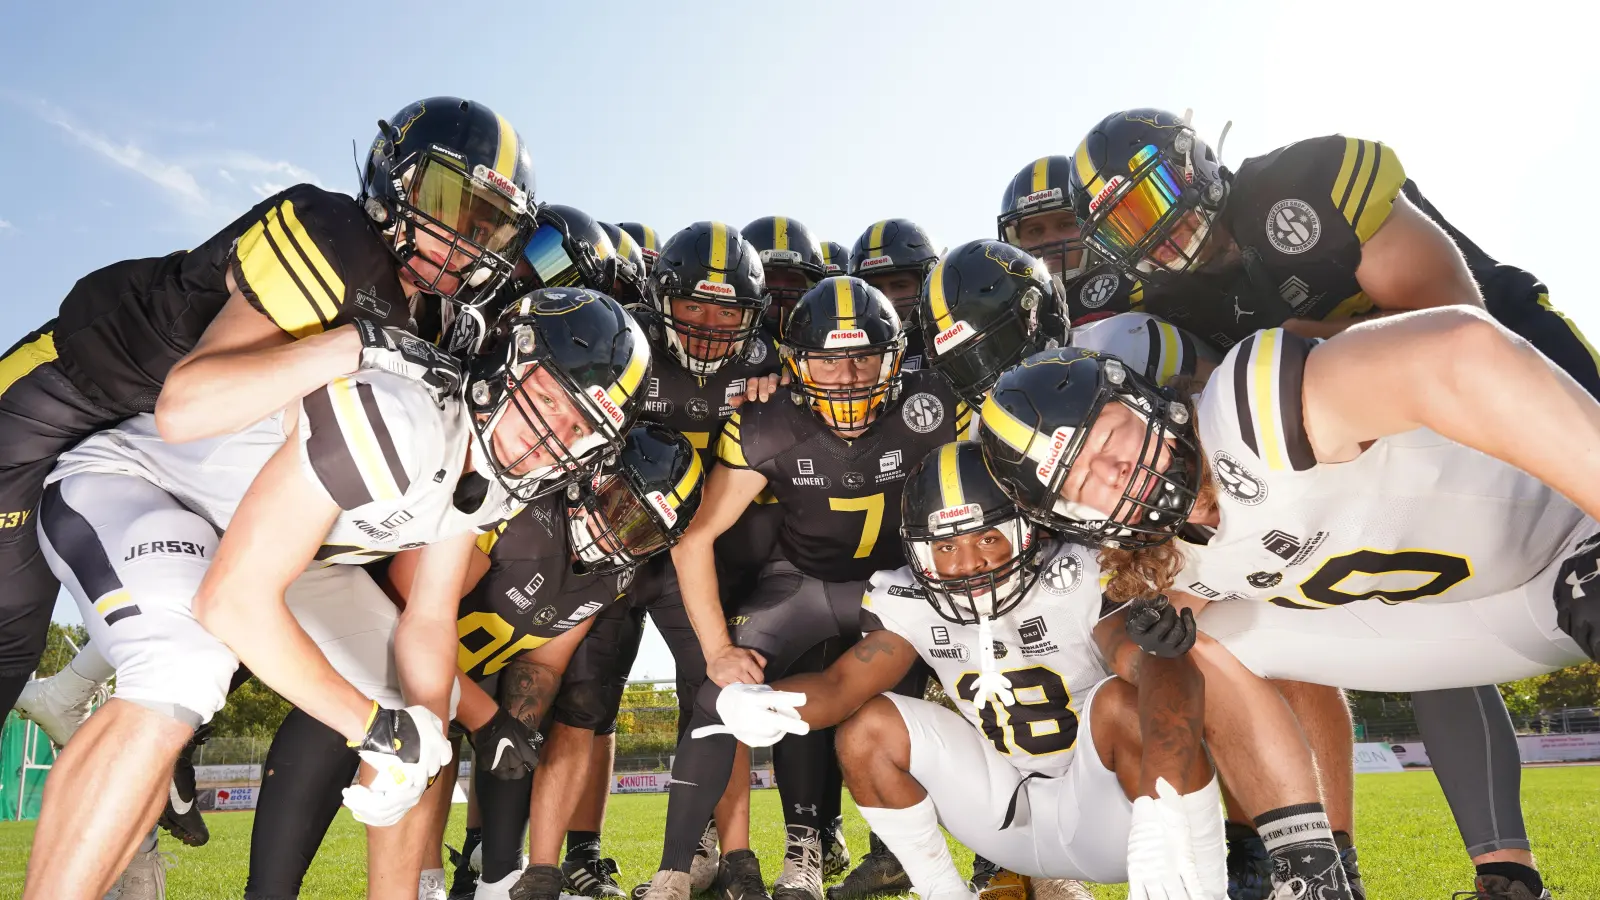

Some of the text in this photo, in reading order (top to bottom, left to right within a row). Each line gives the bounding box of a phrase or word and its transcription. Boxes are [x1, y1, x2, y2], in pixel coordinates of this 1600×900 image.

[487, 171, 516, 196] Riddell
[1089, 177, 1120, 212] Riddell
[1027, 190, 1053, 202] Riddell
[830, 331, 864, 340] Riddell
[936, 323, 964, 346] Riddell
[594, 389, 624, 423] Riddell
[643, 400, 668, 412] NERT
[1038, 431, 1067, 478] Riddell
[792, 477, 825, 486] KUNERT
[655, 494, 677, 521] Riddell
[939, 505, 970, 520] Riddell
[829, 493, 884, 558] 7
[124, 540, 205, 562] JER53Y
[505, 586, 533, 610] KUNERT
[929, 647, 963, 659] KUNERT
[955, 664, 1079, 756] 18
